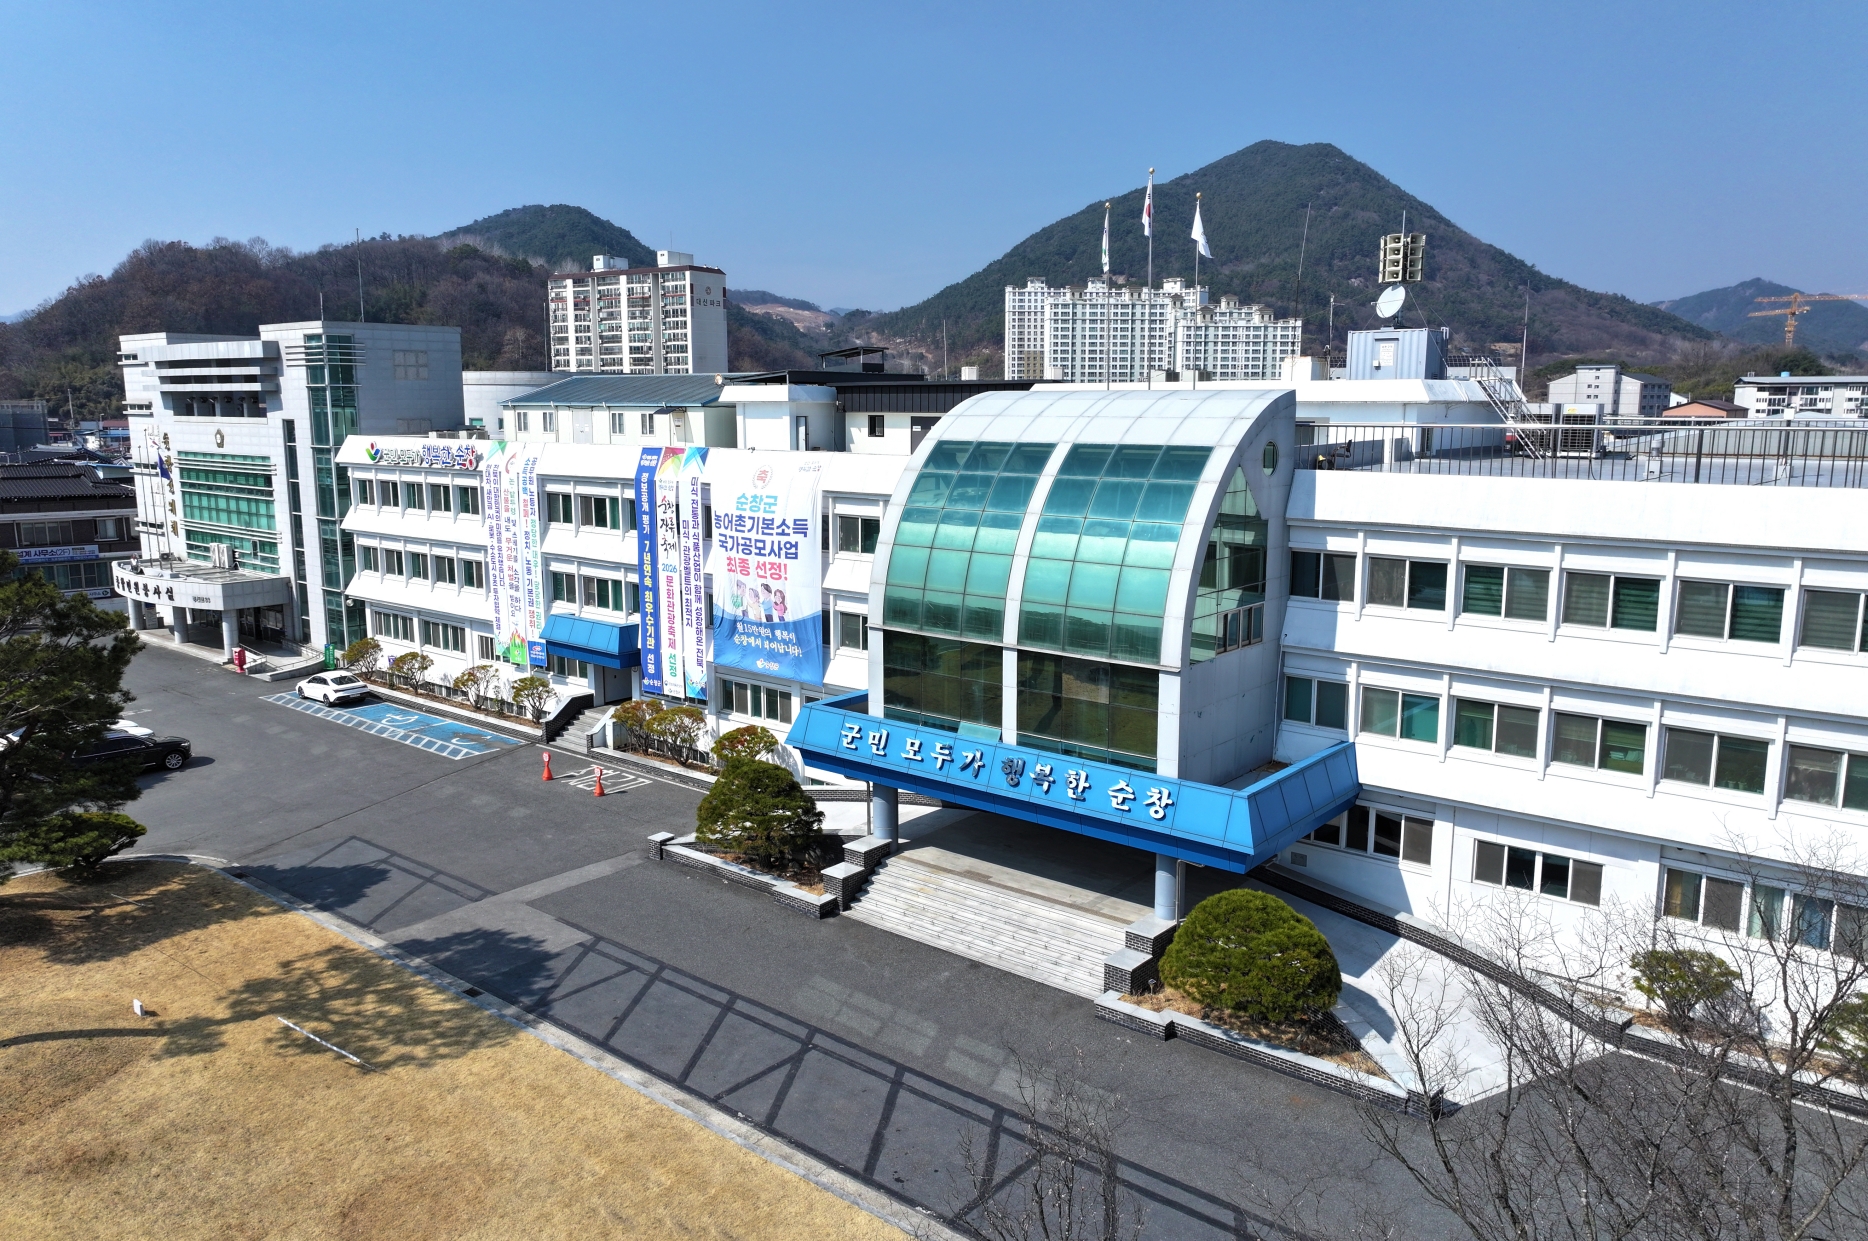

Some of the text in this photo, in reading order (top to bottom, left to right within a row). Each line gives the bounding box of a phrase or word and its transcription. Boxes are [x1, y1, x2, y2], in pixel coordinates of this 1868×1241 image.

[421, 444, 451, 466] 행복한
[454, 443, 477, 469] 순창
[691, 477, 699, 497] 미식
[756, 469, 769, 484] 축
[640, 472, 650, 512] 정보공개
[735, 493, 778, 514] 순창군
[642, 515, 650, 534] 평가
[691, 499, 700, 529] 전통과
[714, 511, 808, 537] 농어촌기본소득
[33, 548, 70, 558] 사무소(2F)
[505, 537, 513, 562] 무거운
[692, 532, 701, 583] 식품산업이
[718, 533, 799, 559] 국가공모사업
[507, 565, 515, 590] 처벌을
[661, 563, 678, 574] 2026
[726, 556, 788, 581] 최종 선정!
[514, 597, 521, 612] 하다
[694, 584, 702, 605] 함께
[644, 590, 655, 649] 최우수기관
[666, 575, 677, 651] 문화관광축제
[695, 606, 704, 646] 성장해온
[774, 629, 796, 643] 행복이
[733, 634, 803, 657] 순창에서 피어납니다!
[647, 653, 655, 674] 선정
[668, 653, 677, 678] 선정
[840, 721, 1176, 821] 군민 모두가 행복한 순창
